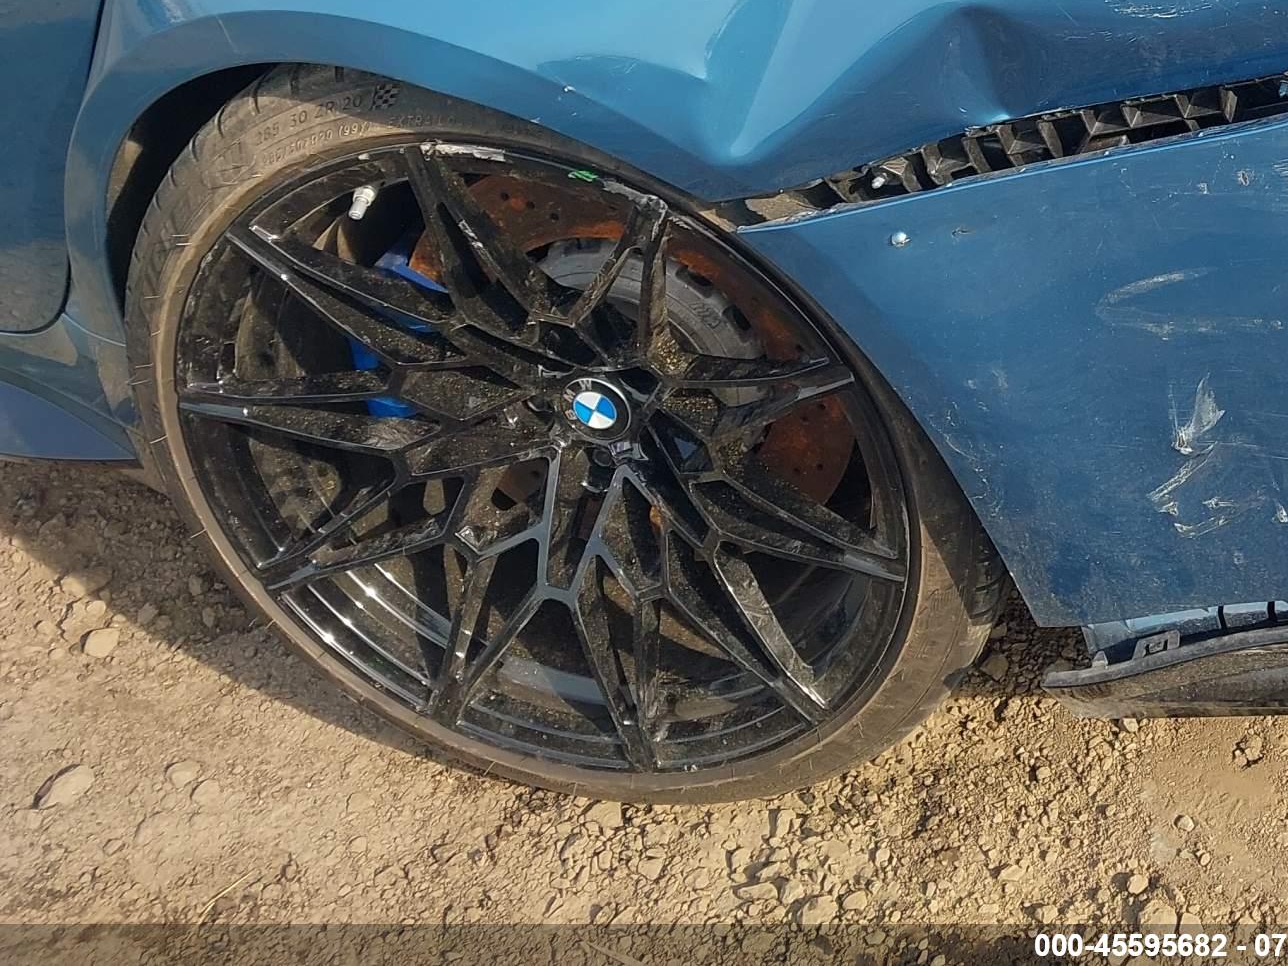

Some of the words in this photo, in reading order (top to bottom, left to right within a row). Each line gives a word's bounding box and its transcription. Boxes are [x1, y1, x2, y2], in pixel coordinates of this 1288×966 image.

[289, 110, 308, 130] 30
[314, 100, 336, 120] ZR
[343, 95, 362, 111] 20
